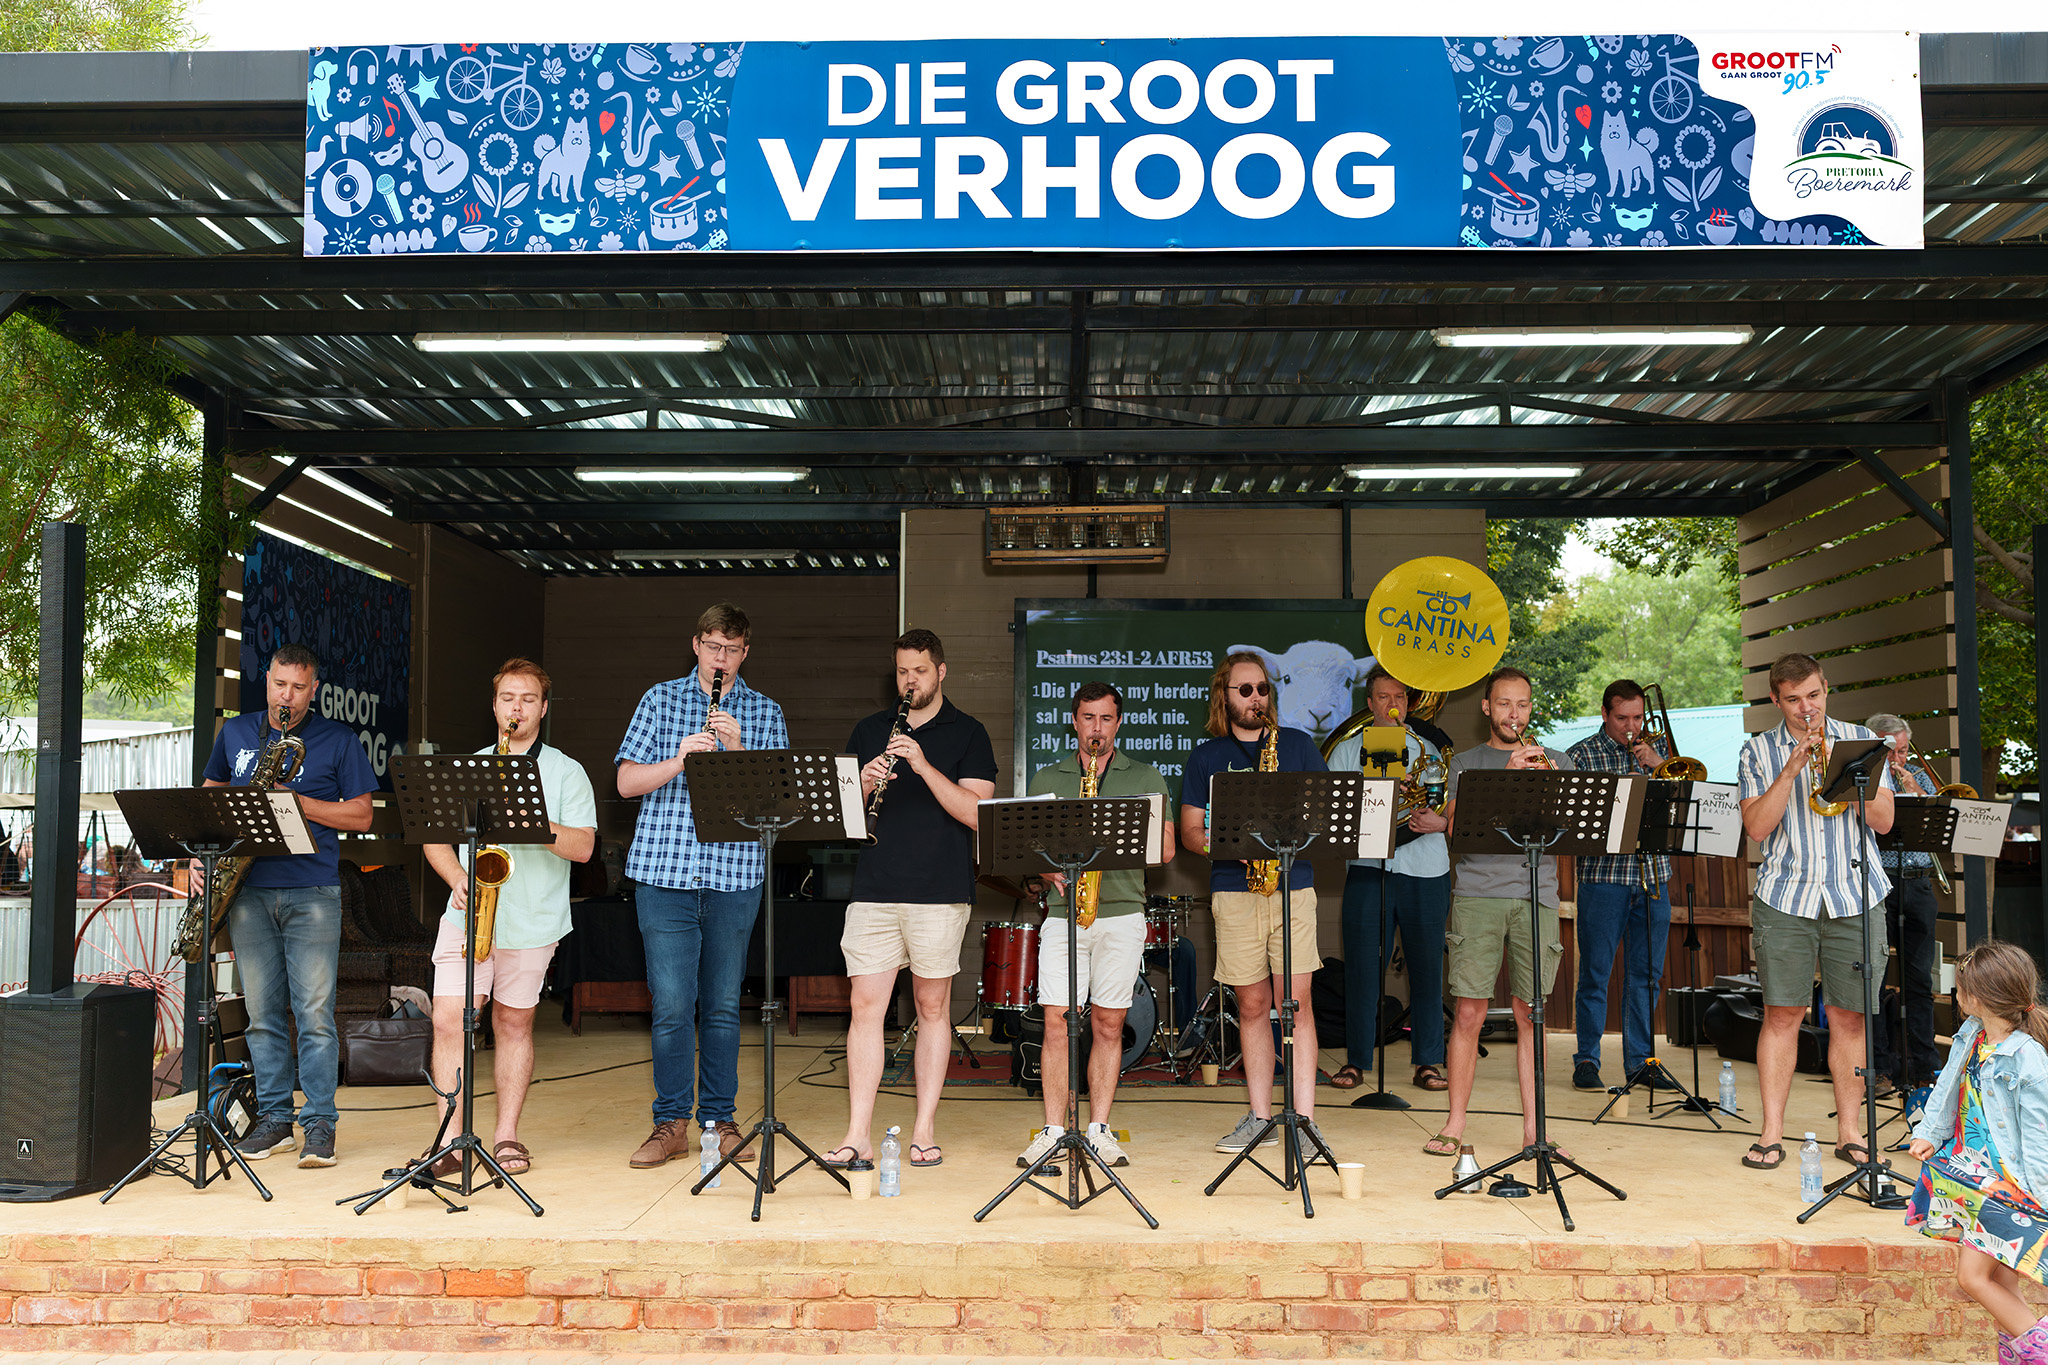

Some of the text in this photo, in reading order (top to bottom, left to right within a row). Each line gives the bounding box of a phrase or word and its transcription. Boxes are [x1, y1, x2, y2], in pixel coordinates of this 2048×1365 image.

[1711, 52, 1834, 70] GROOTFM
[1750, 71, 1782, 79] GROOT
[1782, 70, 1831, 95] 90.5
[827, 58, 1335, 126] DIE GROOT
[757, 131, 1397, 221] VERHOOG
[1787, 168, 1912, 199] Boeremark
[1826, 168, 1884, 177] PRETORIA
[1378, 606, 1496, 646] CANTINA
[1396, 633, 1471, 658] BRASS
[1036, 649, 1213, 666] Psalms 23:1-2 AFR53
[1127, 686, 1150, 702] my
[1154, 682, 1209, 702] herder;
[320, 682, 380, 727] GROOT
[1036, 708, 1058, 725] sal
[1162, 708, 1190, 725] nie.
[1125, 733, 1173, 751] neerlê
[1177, 734, 1192, 751] in
